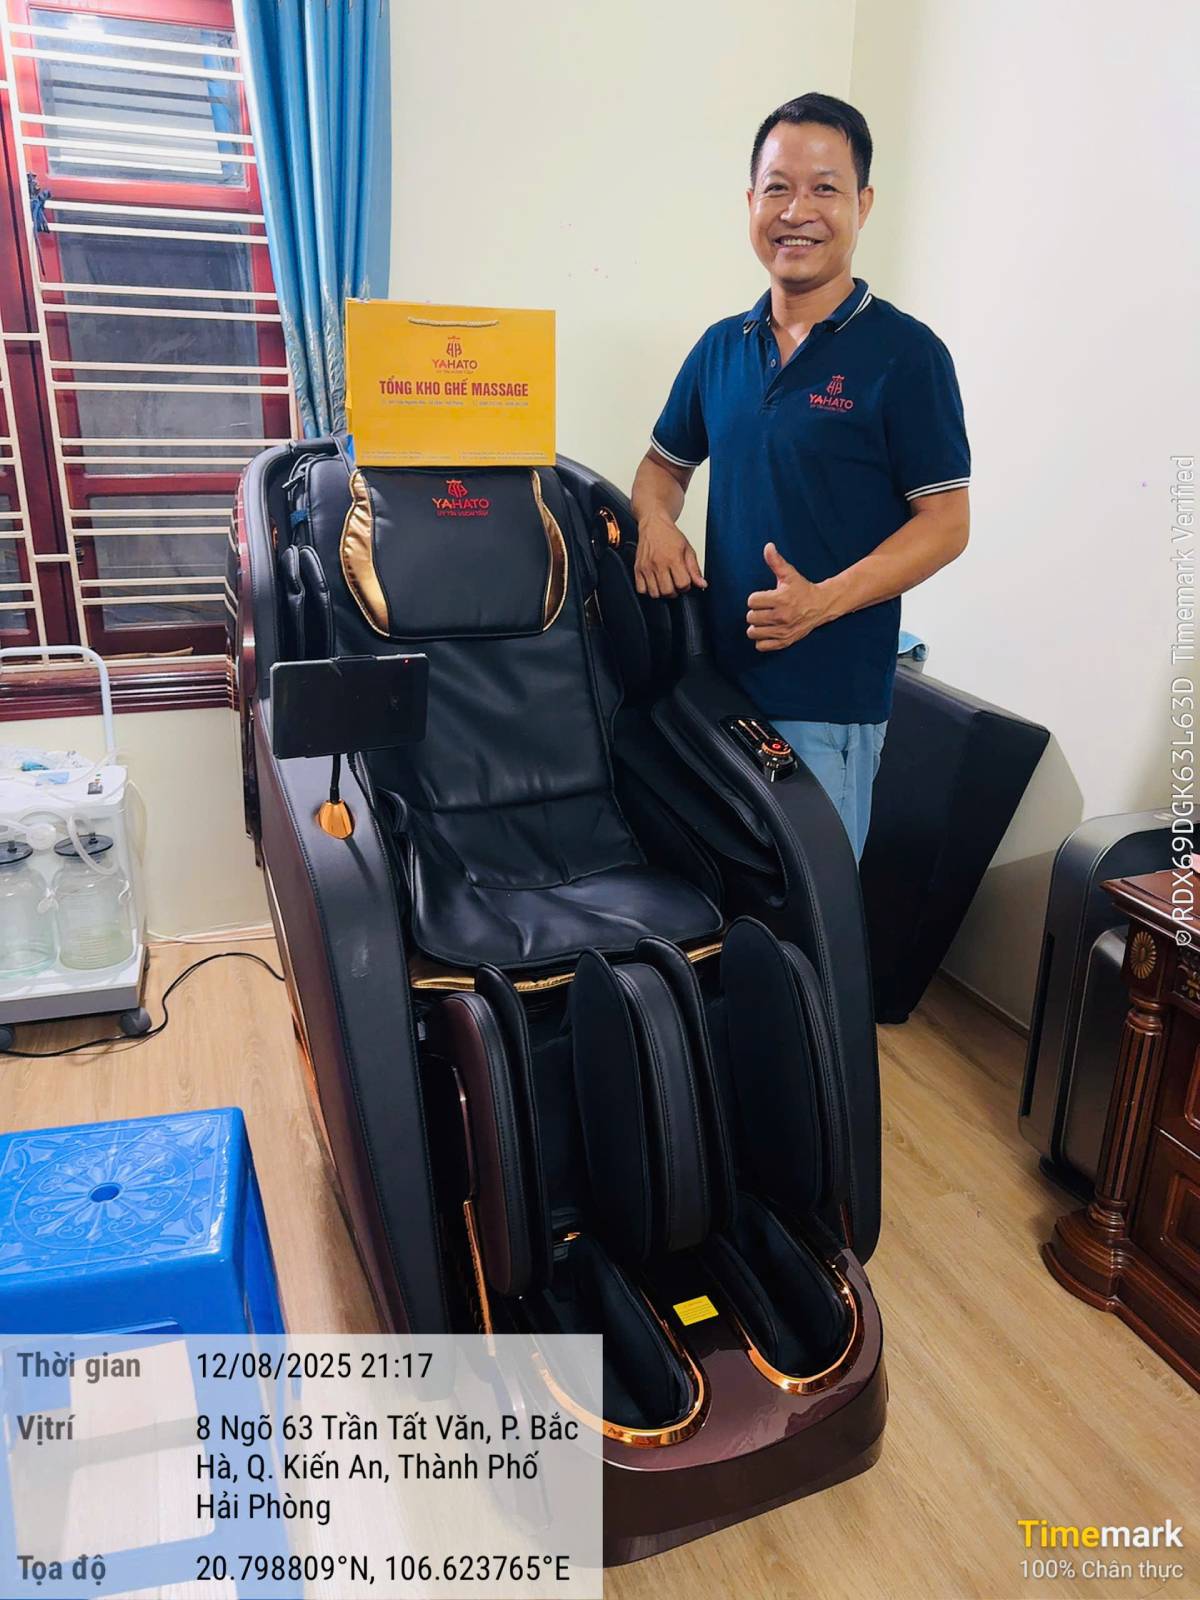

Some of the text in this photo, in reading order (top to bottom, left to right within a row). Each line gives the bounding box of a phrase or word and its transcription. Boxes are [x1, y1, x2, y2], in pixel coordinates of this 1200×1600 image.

[432, 359, 478, 370] YAHATO
[379, 375, 529, 397] TỔNG KHO GHẾ MASSAGE
[809, 393, 854, 410] YAHATO
[431, 497, 490, 509] YAHATO
